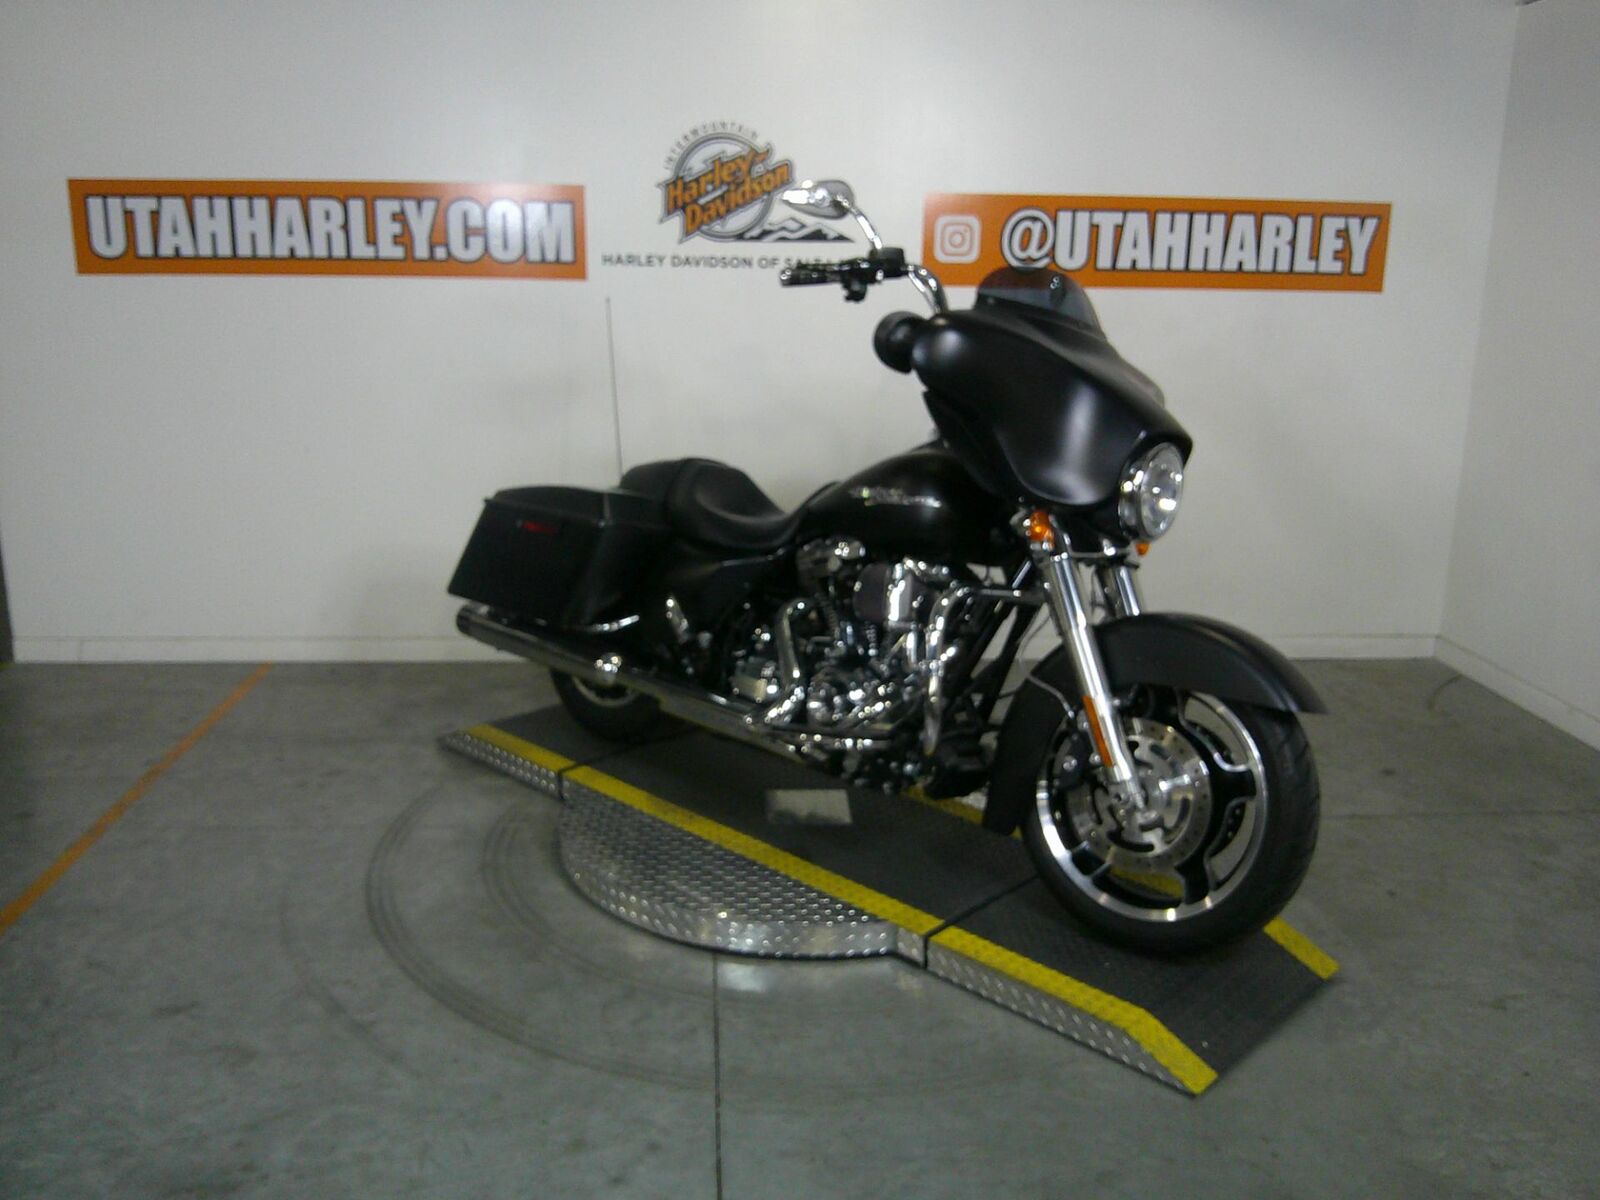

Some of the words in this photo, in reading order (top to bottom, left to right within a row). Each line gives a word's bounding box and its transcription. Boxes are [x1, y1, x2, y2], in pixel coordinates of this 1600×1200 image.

[86, 194, 577, 264] UTAHHARLEY.COM
[684, 162, 790, 237] Davidson
[602, 254, 666, 267] HARLEY
[671, 255, 753, 268] DAVIDSON
[757, 257, 779, 269] OF
[1001, 207, 1382, 276] @UTAHHARLEY
